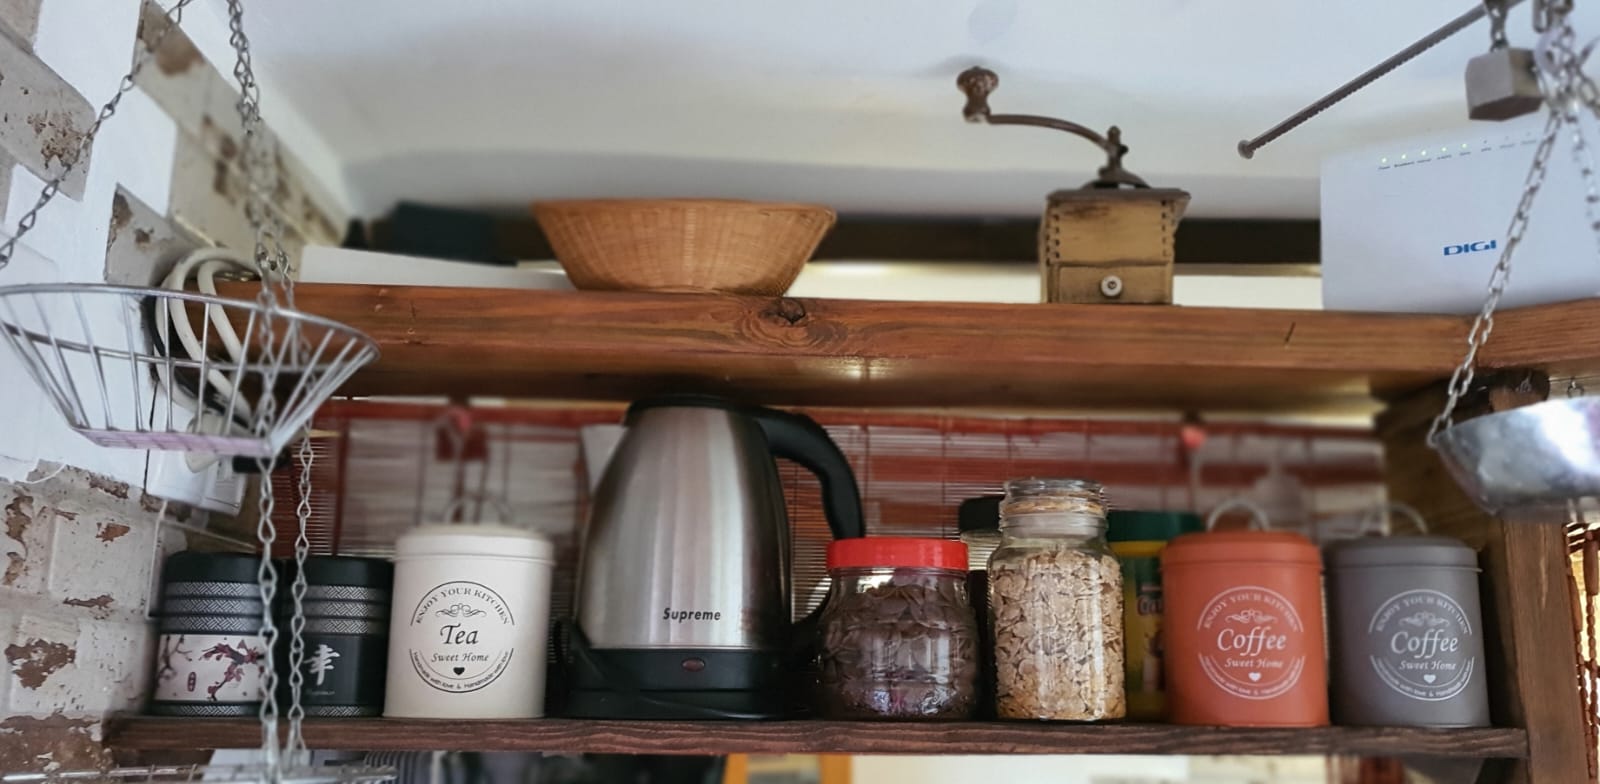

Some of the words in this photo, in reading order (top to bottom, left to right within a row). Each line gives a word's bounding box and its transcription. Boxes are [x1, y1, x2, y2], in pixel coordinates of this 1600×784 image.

[1443, 239, 1497, 256] DIGI
[416, 594, 438, 624] ENJOY
[441, 587, 472, 598] YOUR
[474, 589, 510, 625] KITCHEN
[663, 607, 721, 623] Supreme
[1203, 601, 1227, 629] ENJOY
[1229, 593, 1262, 603] YOUR
[440, 622, 479, 645] Tea
[1217, 626, 1287, 657] Coffee
[1391, 628, 1459, 659] Coffee
[431, 652, 459, 663] Sweet
[462, 652, 489, 662] Home
[1224, 658, 1254, 668] Sweet
[1256, 658, 1283, 669] Home
[1399, 660, 1429, 670] Sweet
[1430, 660, 1457, 671] Home
